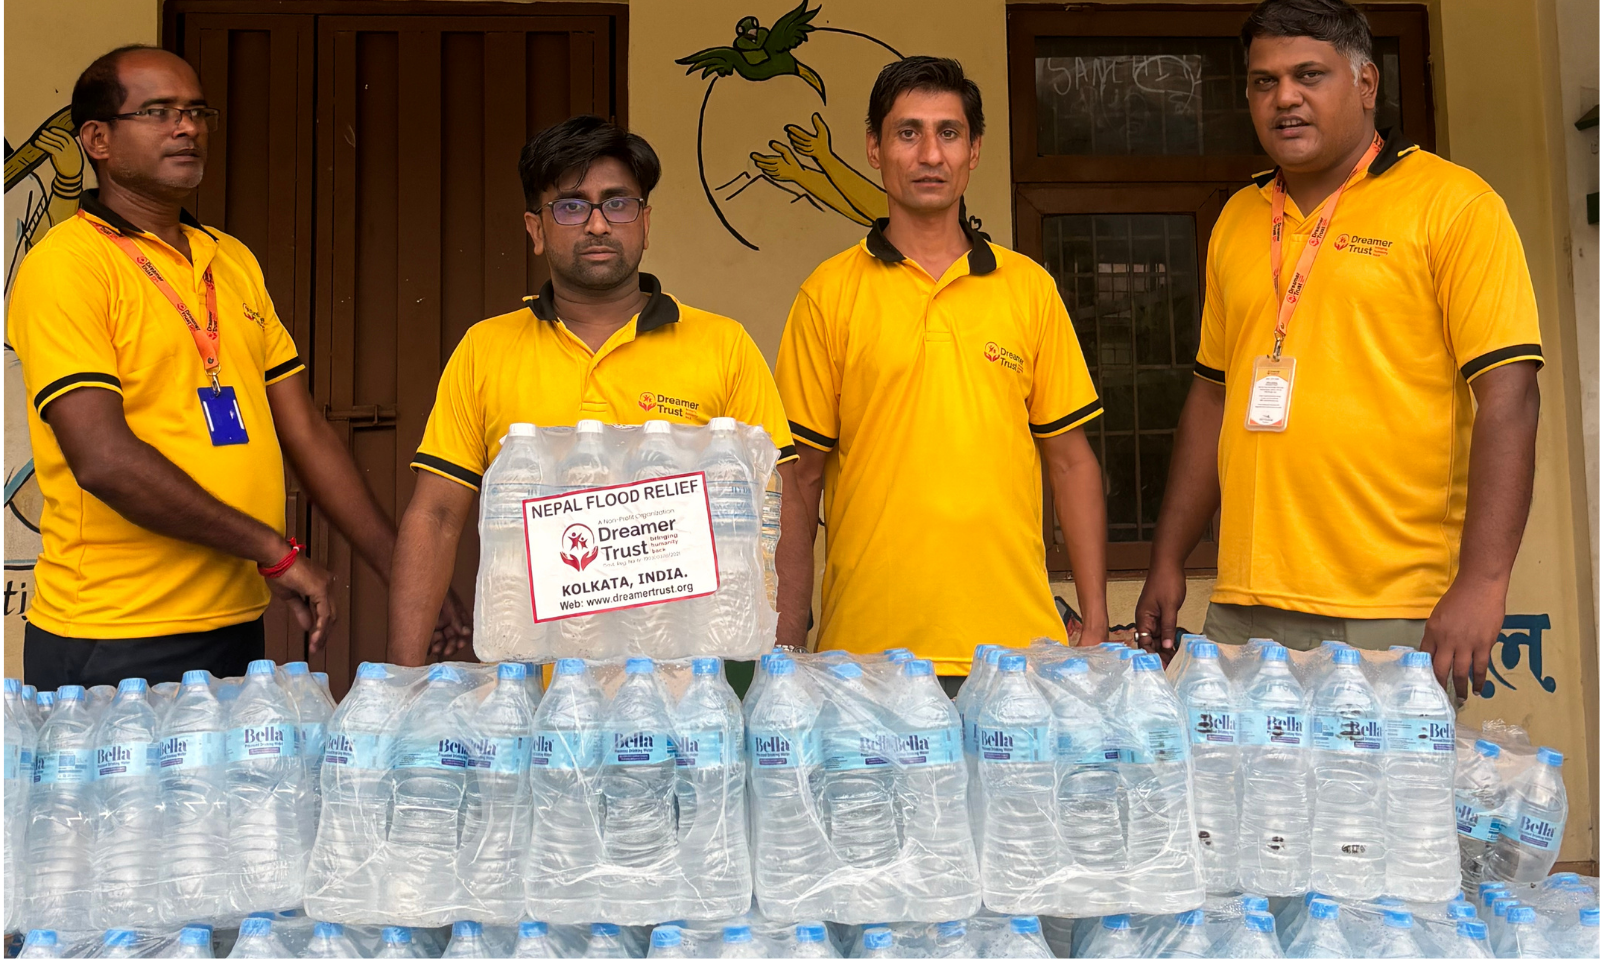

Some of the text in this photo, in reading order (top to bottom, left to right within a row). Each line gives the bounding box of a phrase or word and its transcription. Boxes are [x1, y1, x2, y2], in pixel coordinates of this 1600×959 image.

[1349, 244, 1373, 255] Trust
[1351, 235, 1393, 248] Dreamer
[657, 394, 699, 410] Dreamer
[657, 404, 683, 417] Trust
[531, 479, 699, 519] NEPAL FLOOD RELIEF
[598, 518, 676, 542] Dreamer
[650, 533, 678, 541] bringing
[601, 540, 649, 561] Trust
[651, 539, 678, 547] humanity
[562, 567, 688, 597] KOLKATA, INDIA.
[560, 582, 694, 611] Web: www.dreamertrust.org
[1200, 714, 1236, 730] Bella
[1266, 716, 1302, 732] Bella
[245, 726, 284, 744] Bella
[615, 732, 653, 749] Bella
[982, 730, 1013, 747] Bella
[533, 736, 553, 752] ella
[756, 736, 790, 752] Bella
[97, 746, 131, 764] Bella
[1520, 816, 1555, 838] Bella
